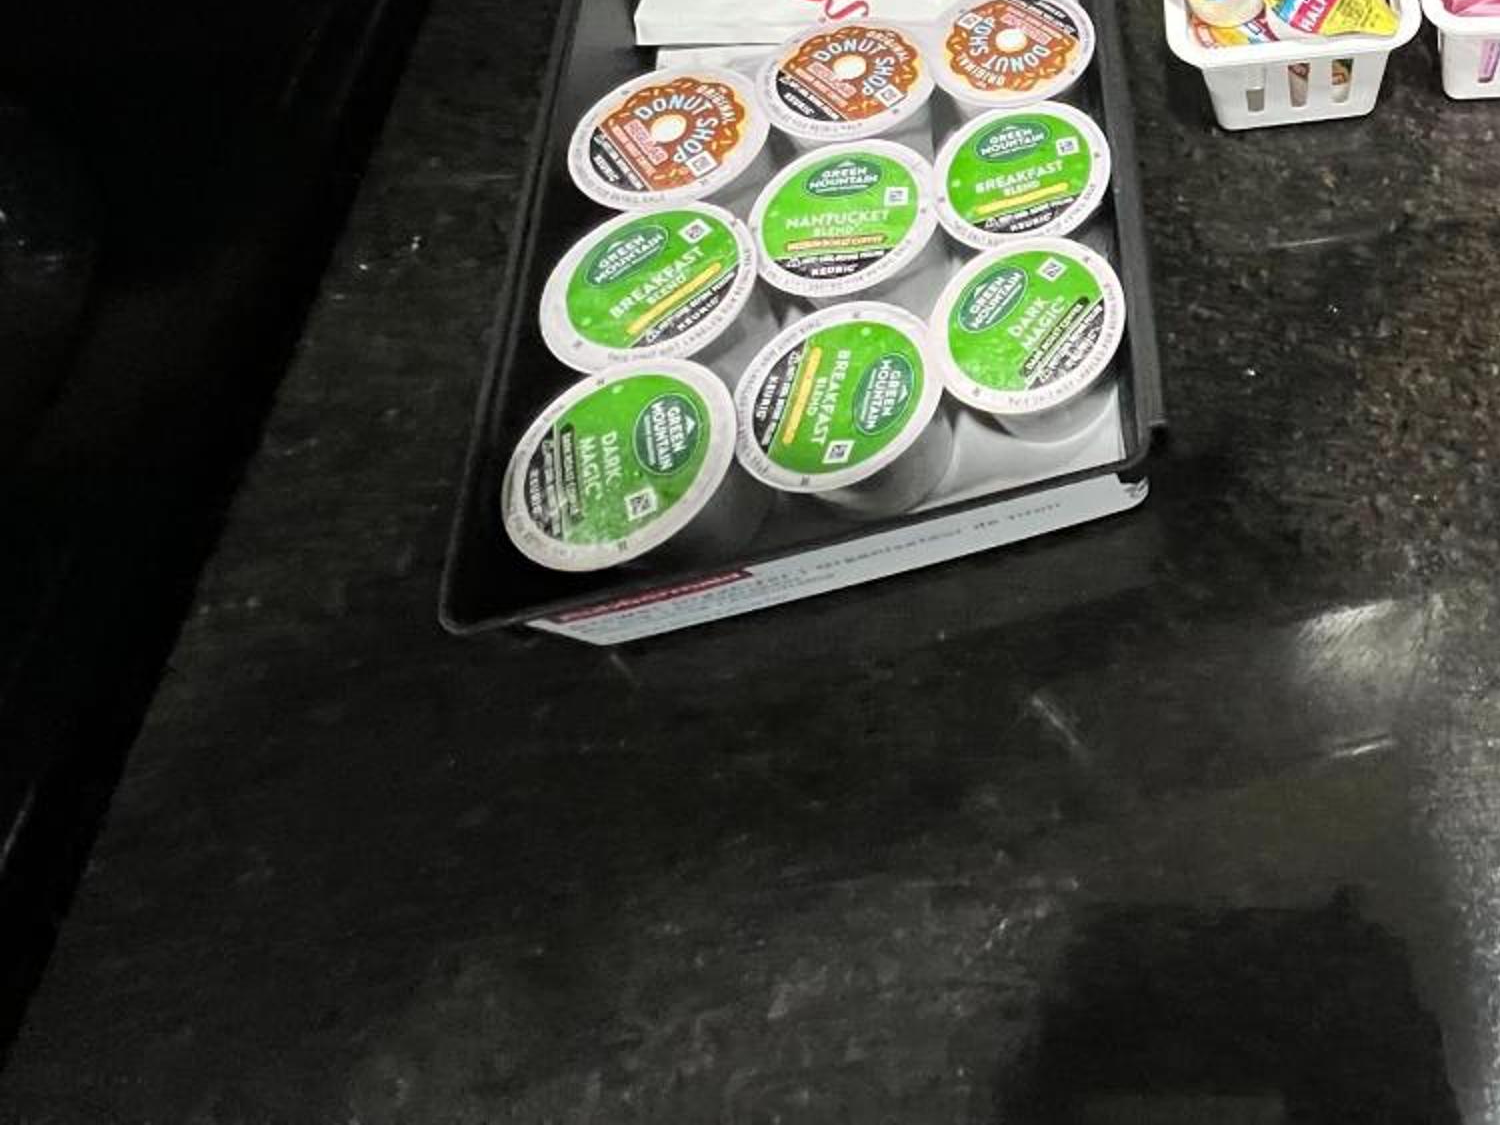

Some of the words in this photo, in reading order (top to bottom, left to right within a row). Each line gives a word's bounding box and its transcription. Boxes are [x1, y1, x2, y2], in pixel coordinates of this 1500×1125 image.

[967, 16, 996, 57] SHOP
[981, 43, 1052, 74] DONUT
[811, 38, 889, 63] DONUT
[861, 56, 896, 96] SHOP
[634, 94, 713, 120] DONUT
[673, 117, 720, 164] SHOP
[980, 132, 1045, 156] MOUNTAIN
[989, 128, 1033, 144] GREEN
[808, 173, 879, 190] MOUNTAIN
[820, 165, 868, 178] GREEN
[975, 160, 1064, 194] BREAKFAST
[785, 210, 890, 230] NANTUCKET
[594, 233, 665, 284] MOUNTAIN
[599, 234, 646, 269] GREEN
[608, 246, 705, 319] BREAKFAST
[970, 276, 1006, 315] GREEN
[973, 271, 1024, 330] MOUNTAIN
[1008, 297, 1047, 338] DARK
[1020, 294, 1064, 351] MAGIC
[755, 375, 780, 421] KEURIG
[811, 349, 851, 445] BREAKFAST
[864, 359, 893, 430] MOUNTAIN
[882, 370, 902, 417] GREEN
[650, 401, 674, 471] MOUNTAIN
[666, 405, 687, 453] GREEN
[578, 435, 603, 494] MAGIC
[601, 430, 624, 490] DARK
